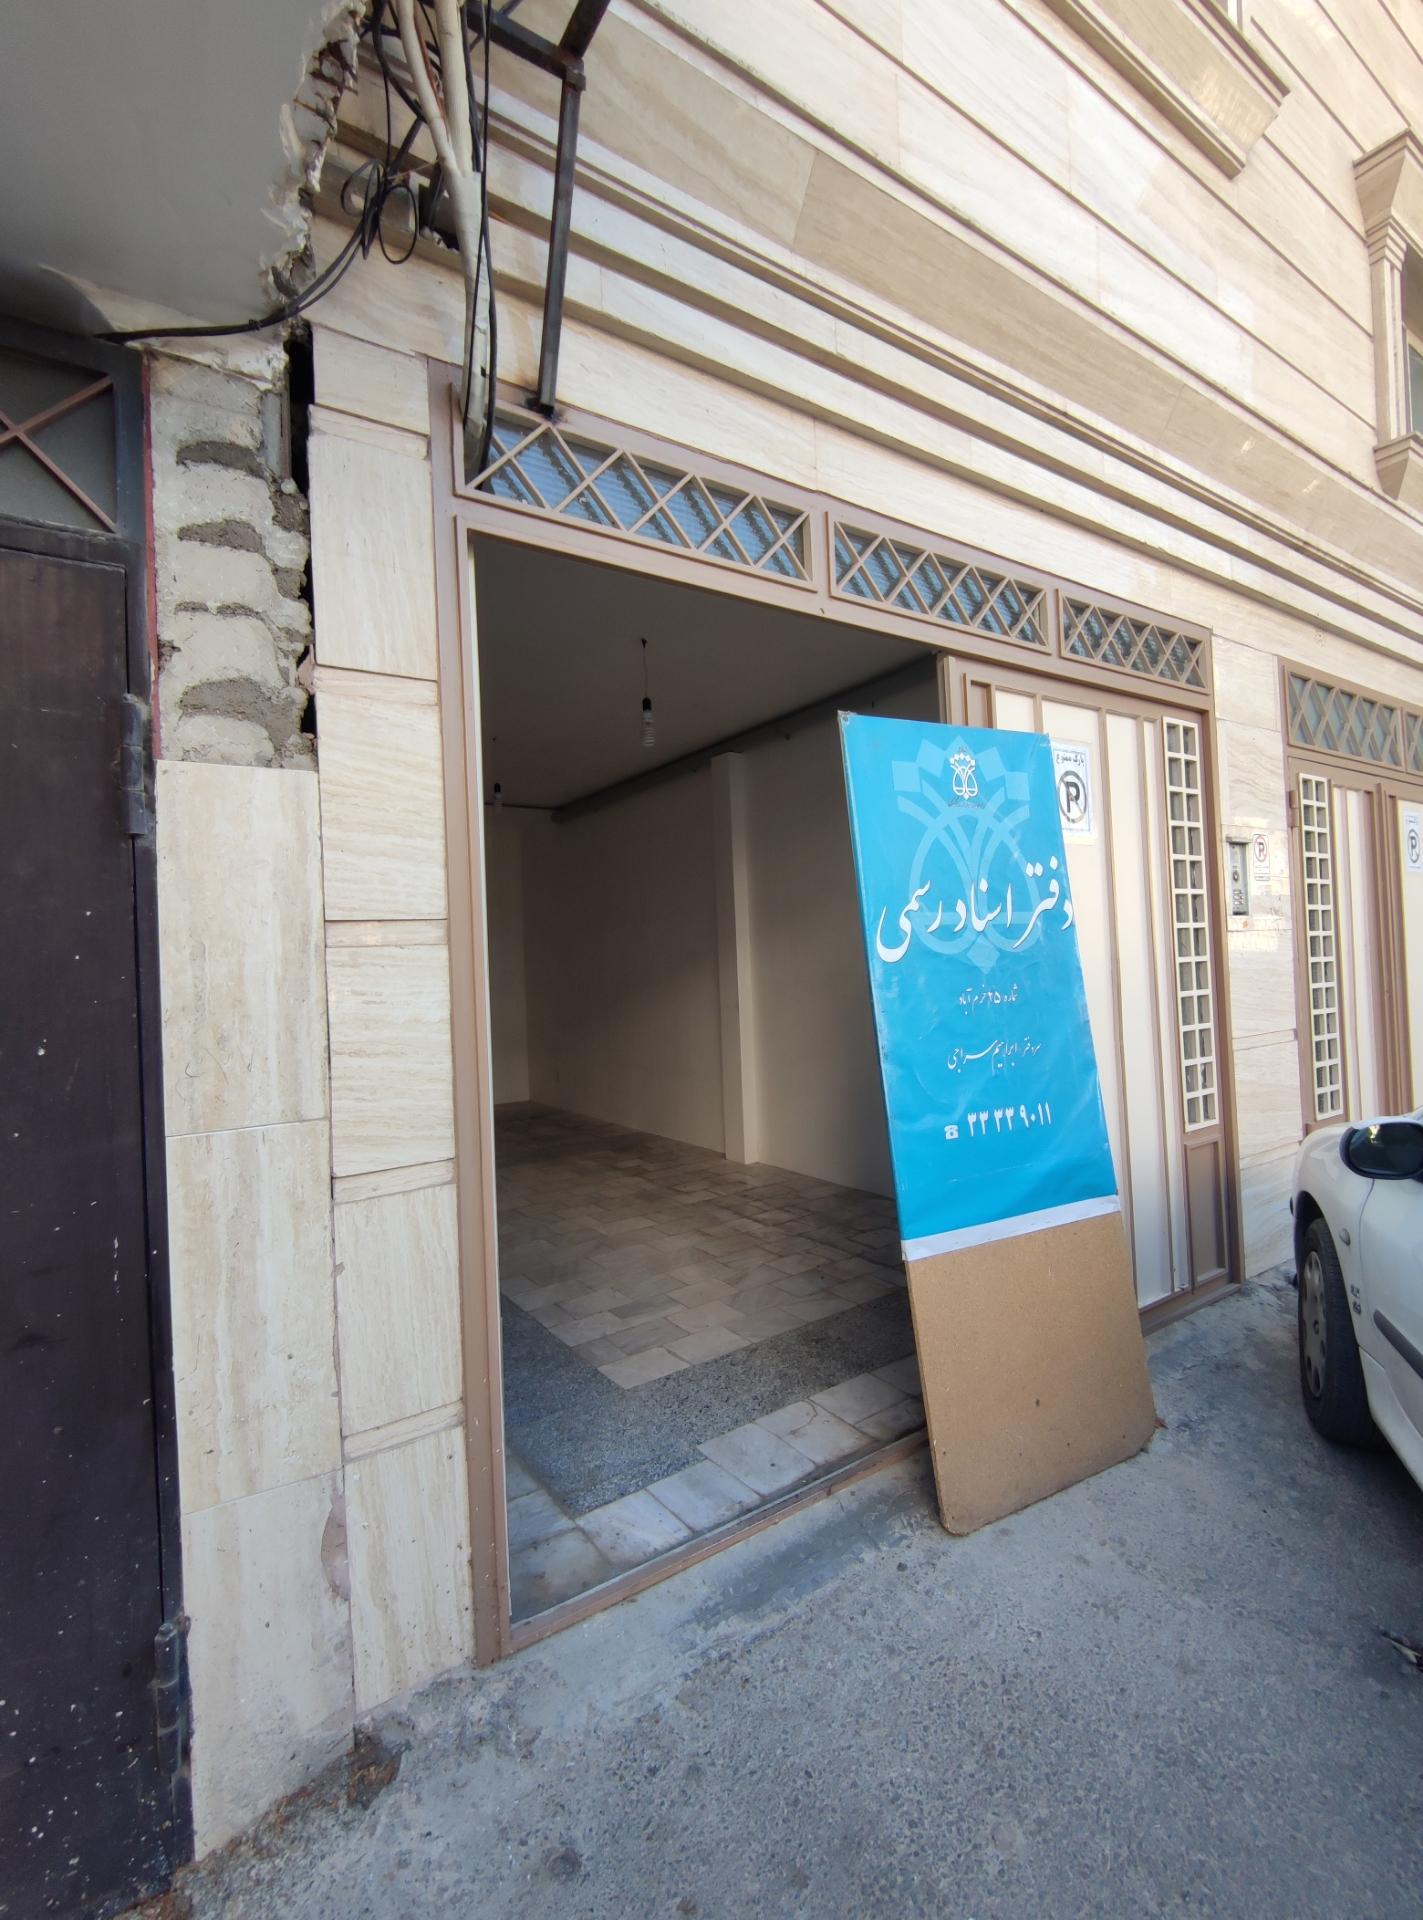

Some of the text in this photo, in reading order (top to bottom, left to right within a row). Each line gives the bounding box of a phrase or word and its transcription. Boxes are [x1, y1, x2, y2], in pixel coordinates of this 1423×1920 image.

[875, 855, 1075, 963] دفتر اسناد رسمی
